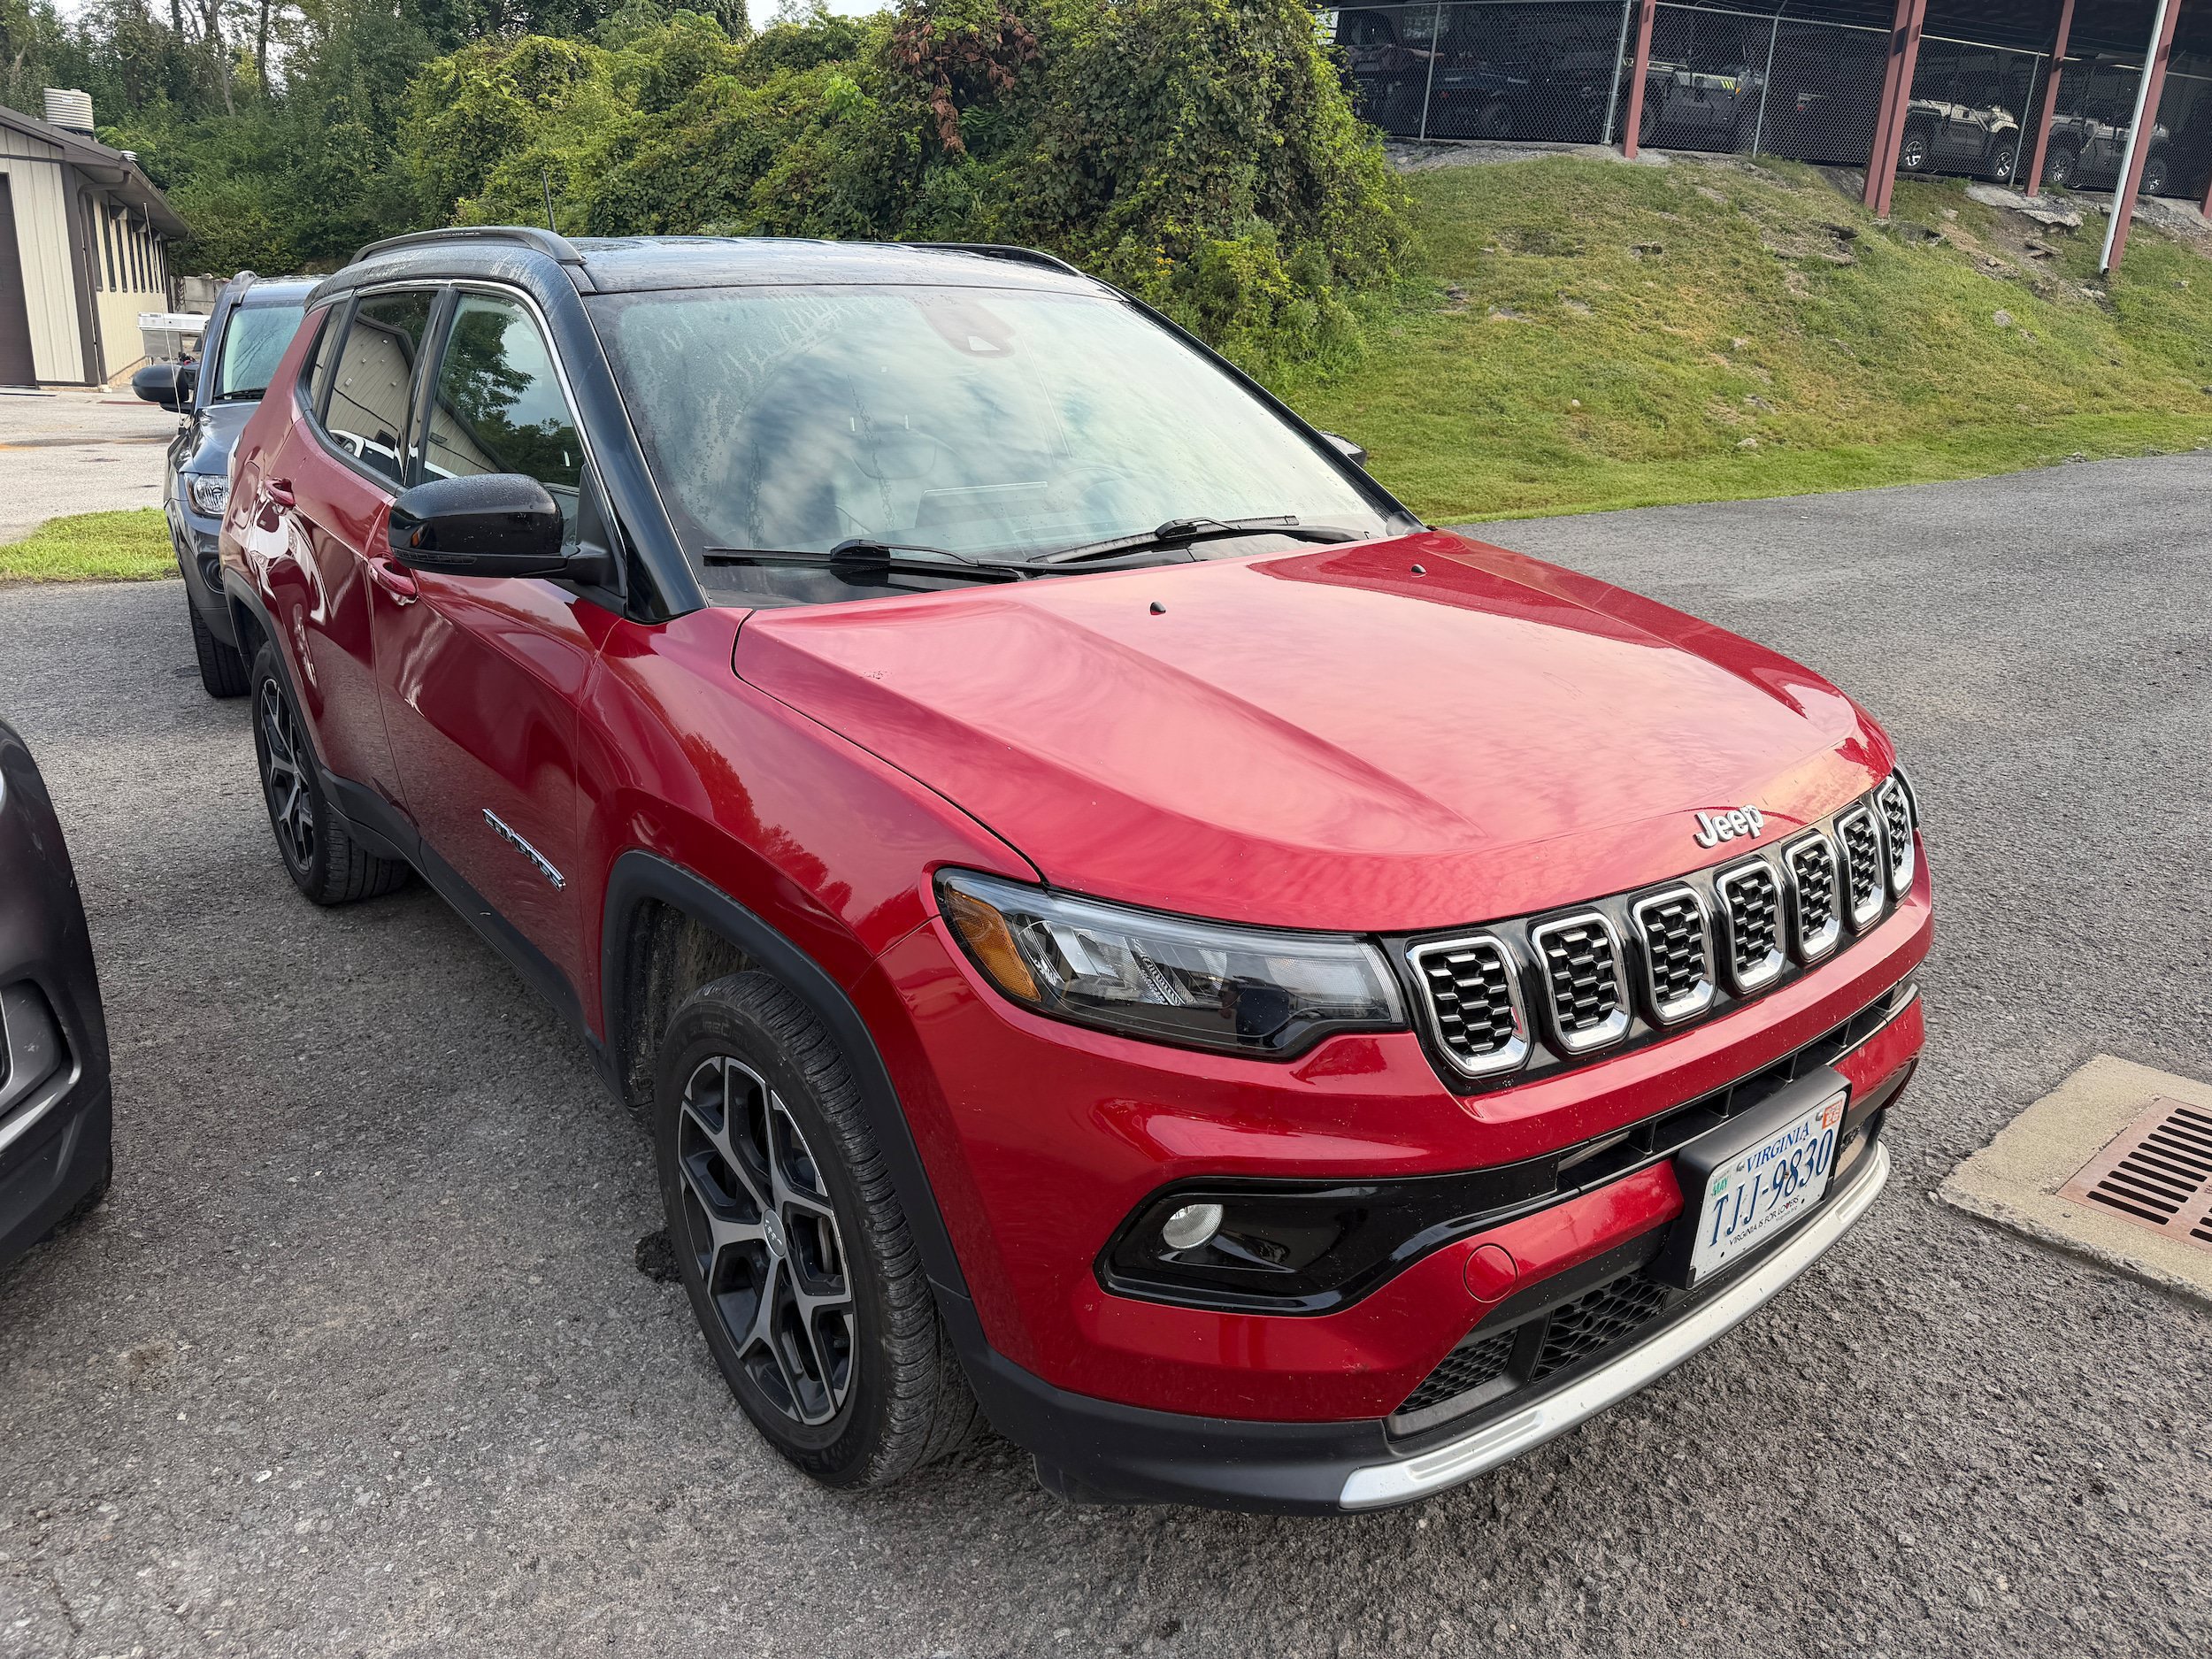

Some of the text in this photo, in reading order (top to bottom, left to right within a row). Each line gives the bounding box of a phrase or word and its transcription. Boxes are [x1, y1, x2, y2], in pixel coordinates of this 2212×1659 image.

[1693, 803, 1764, 849] Jeep
[1825, 1110, 1840, 1125] 26
[1747, 1121, 1810, 1174] VIRGINIA
[1709, 1129, 1833, 1248] TJJ-9830
[1729, 1225, 1757, 1245] VIRGINIA
[1758, 1219, 1763, 1228] IS
[1764, 1211, 1777, 1225] FOR
